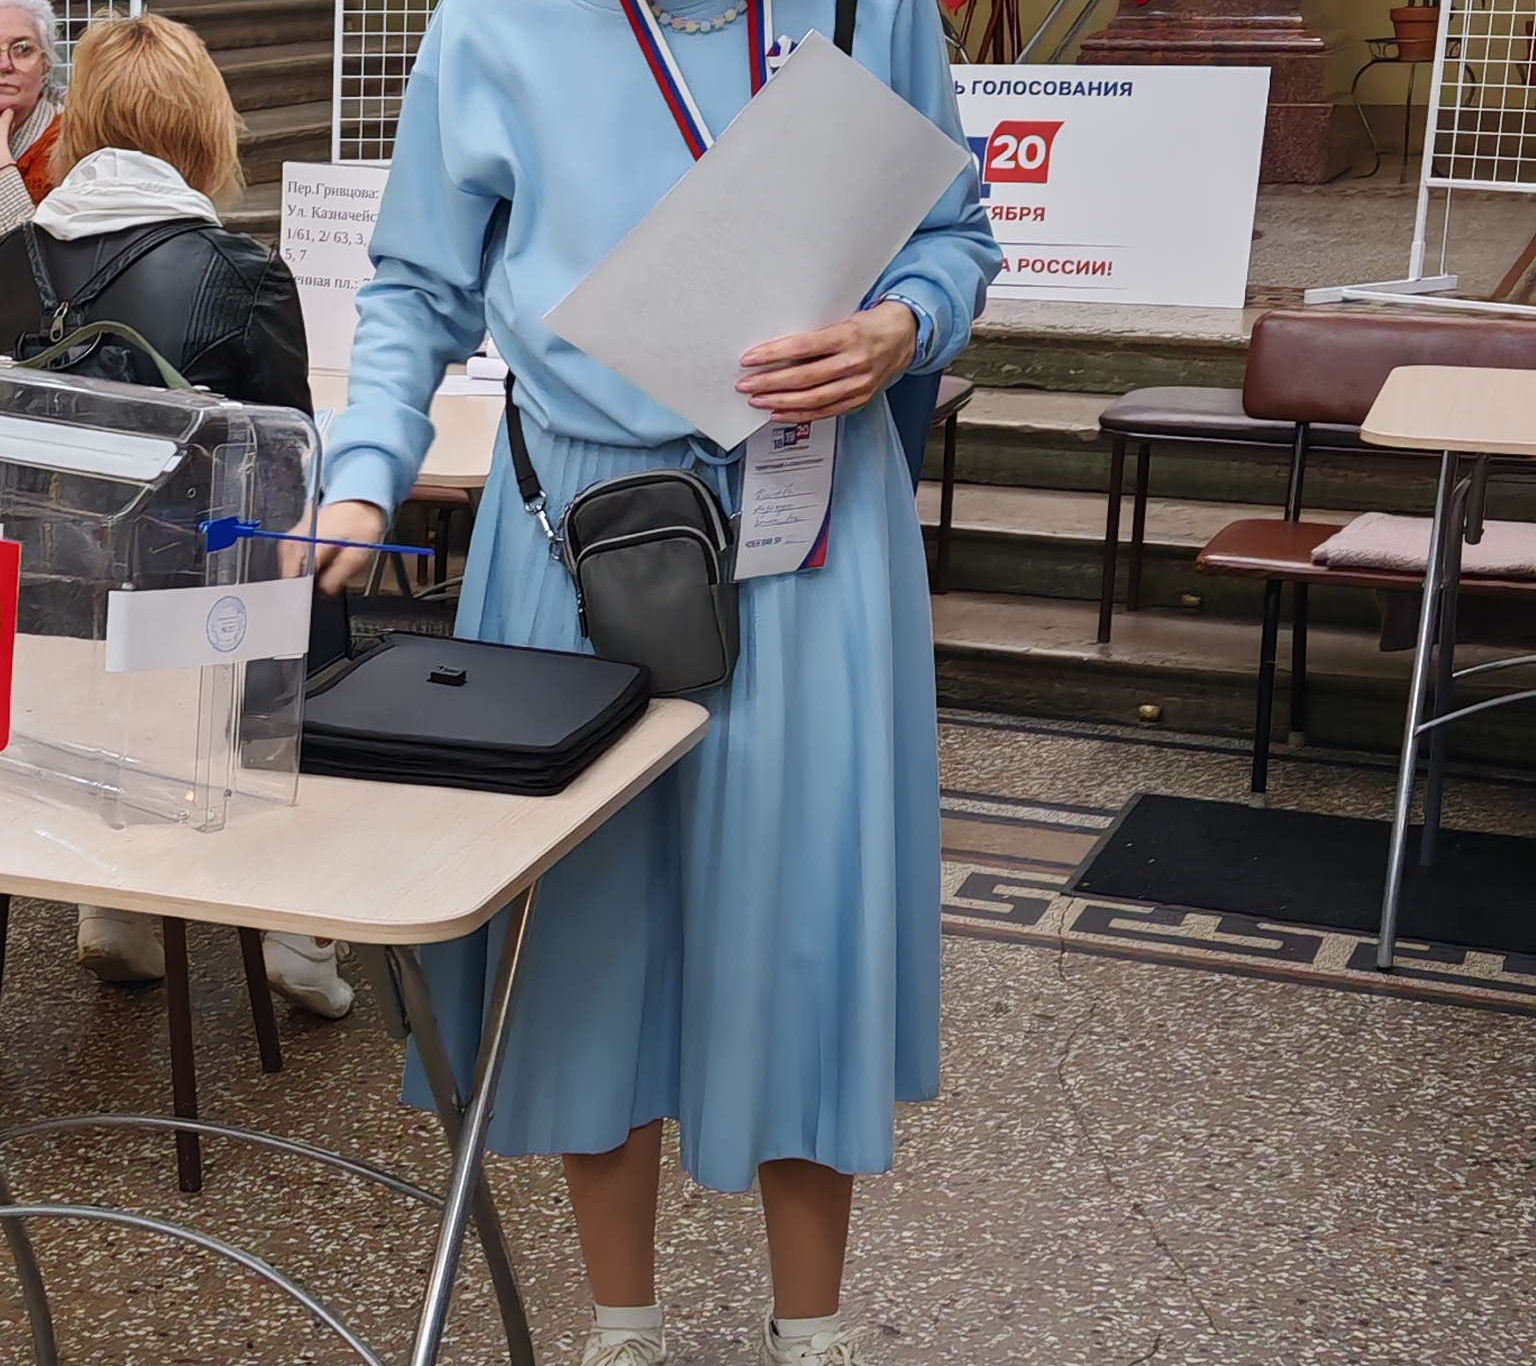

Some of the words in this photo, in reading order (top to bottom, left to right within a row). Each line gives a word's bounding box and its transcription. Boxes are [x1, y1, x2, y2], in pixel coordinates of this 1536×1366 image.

[971, 80, 1133, 97] ГОЛОСОВАНИЯ
[990, 134, 1047, 170] 20
[287, 204, 306, 218] Ул.
[312, 206, 378, 223] Казначейс
[985, 205, 1046, 222] ЯБРЯ
[1017, 257, 1113, 277] РОССИИ!
